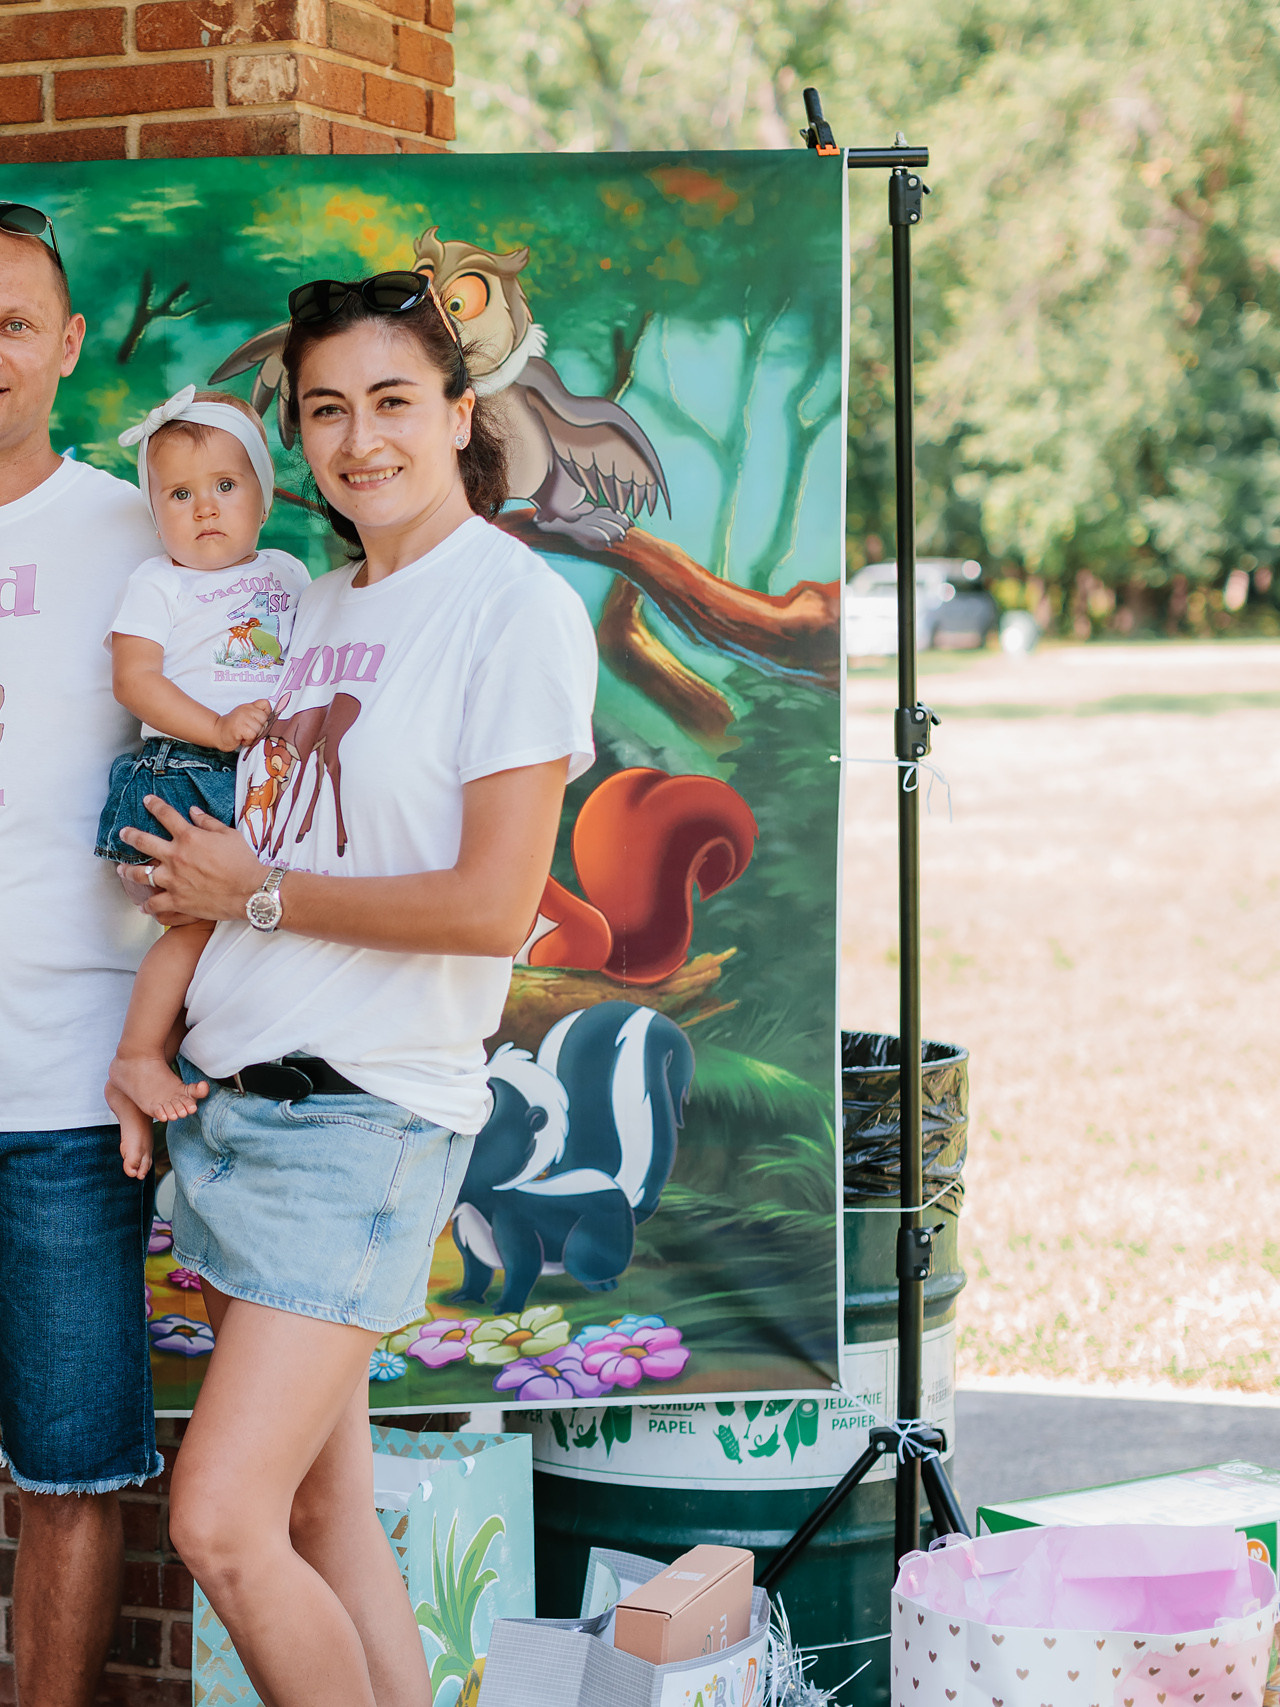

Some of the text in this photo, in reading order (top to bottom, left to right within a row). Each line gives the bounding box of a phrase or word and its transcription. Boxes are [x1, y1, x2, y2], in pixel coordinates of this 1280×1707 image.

[213, 669, 281, 685] Birthday
[268, 642, 386, 702] Mom
[639, 1402, 706, 1411] MIDA
[648, 1418, 697, 1435] PAPEL
[831, 1414, 876, 1431] PAPIER
